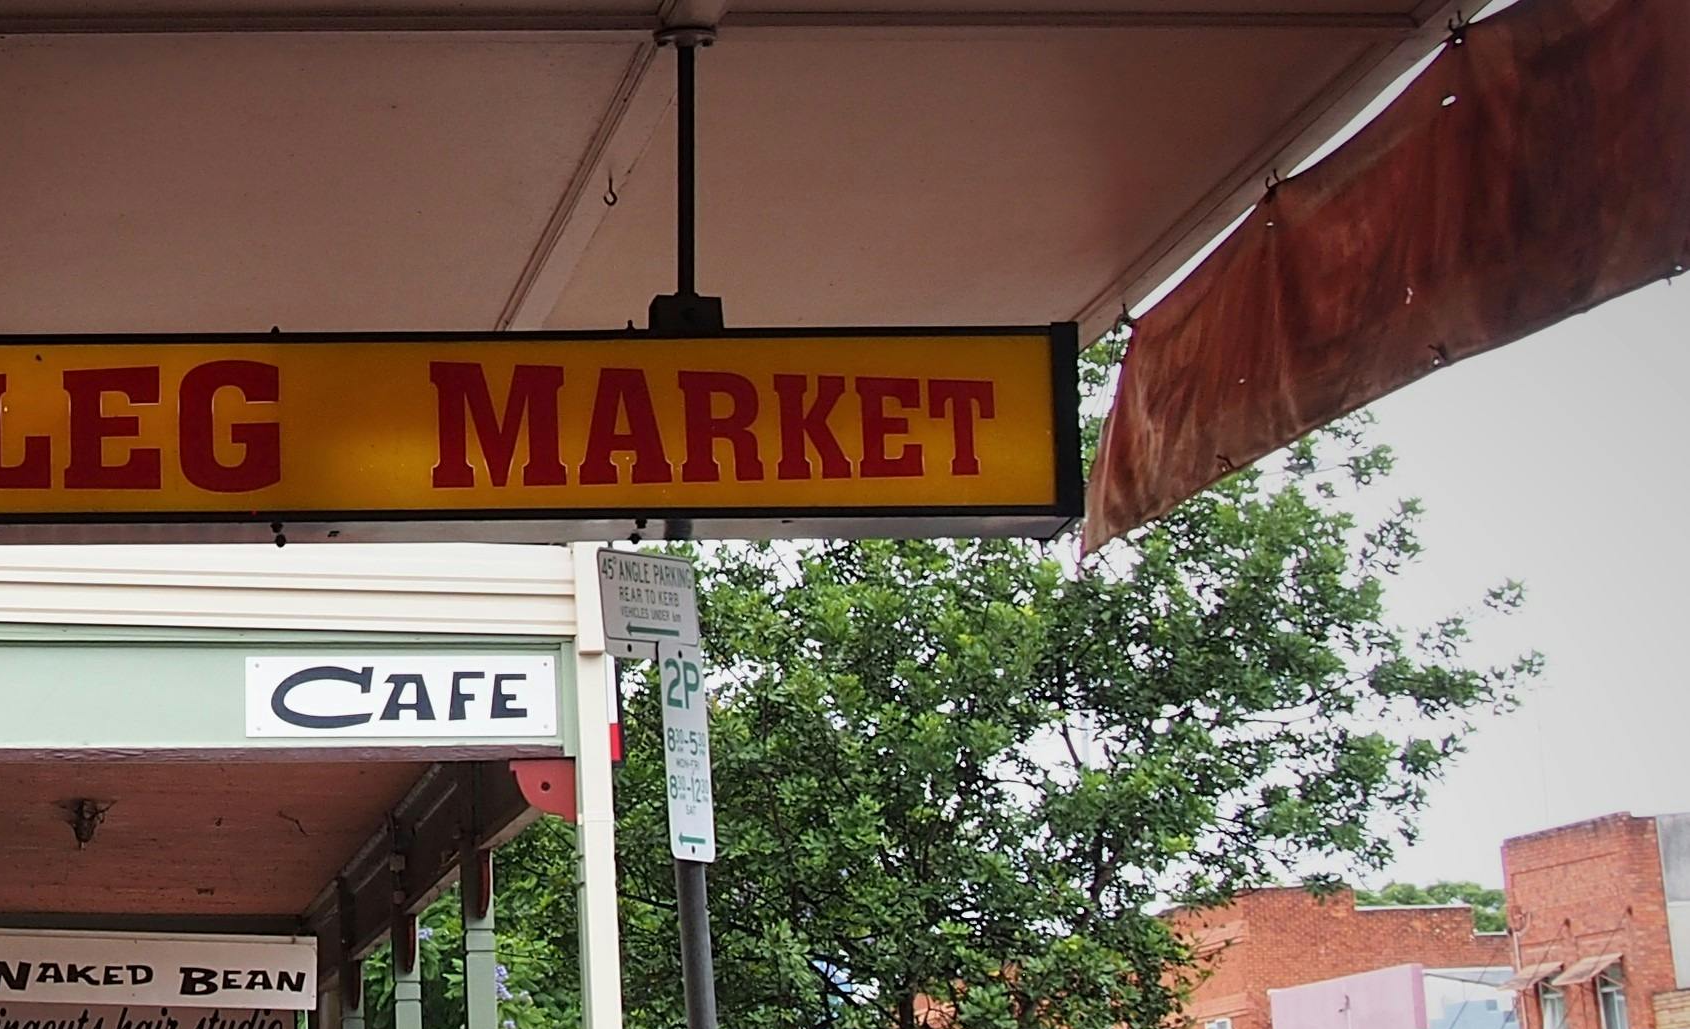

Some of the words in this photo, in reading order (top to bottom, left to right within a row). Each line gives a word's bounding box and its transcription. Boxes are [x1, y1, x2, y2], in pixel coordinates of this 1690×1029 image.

[429, 361, 995, 489] MARKET
[619, 559, 650, 584] ANGLE
[653, 564, 692, 589] PARKING
[619, 586, 642, 603] REAR
[645, 588, 656, 604] TO
[658, 591, 680, 608] KERB
[621, 605, 650, 619] VEHICLES
[652, 609, 670, 621] UNDER
[271, 666, 528, 729] CAFE
[664, 657, 700, 710] 2P
[179, 967, 306, 995] BEAN
